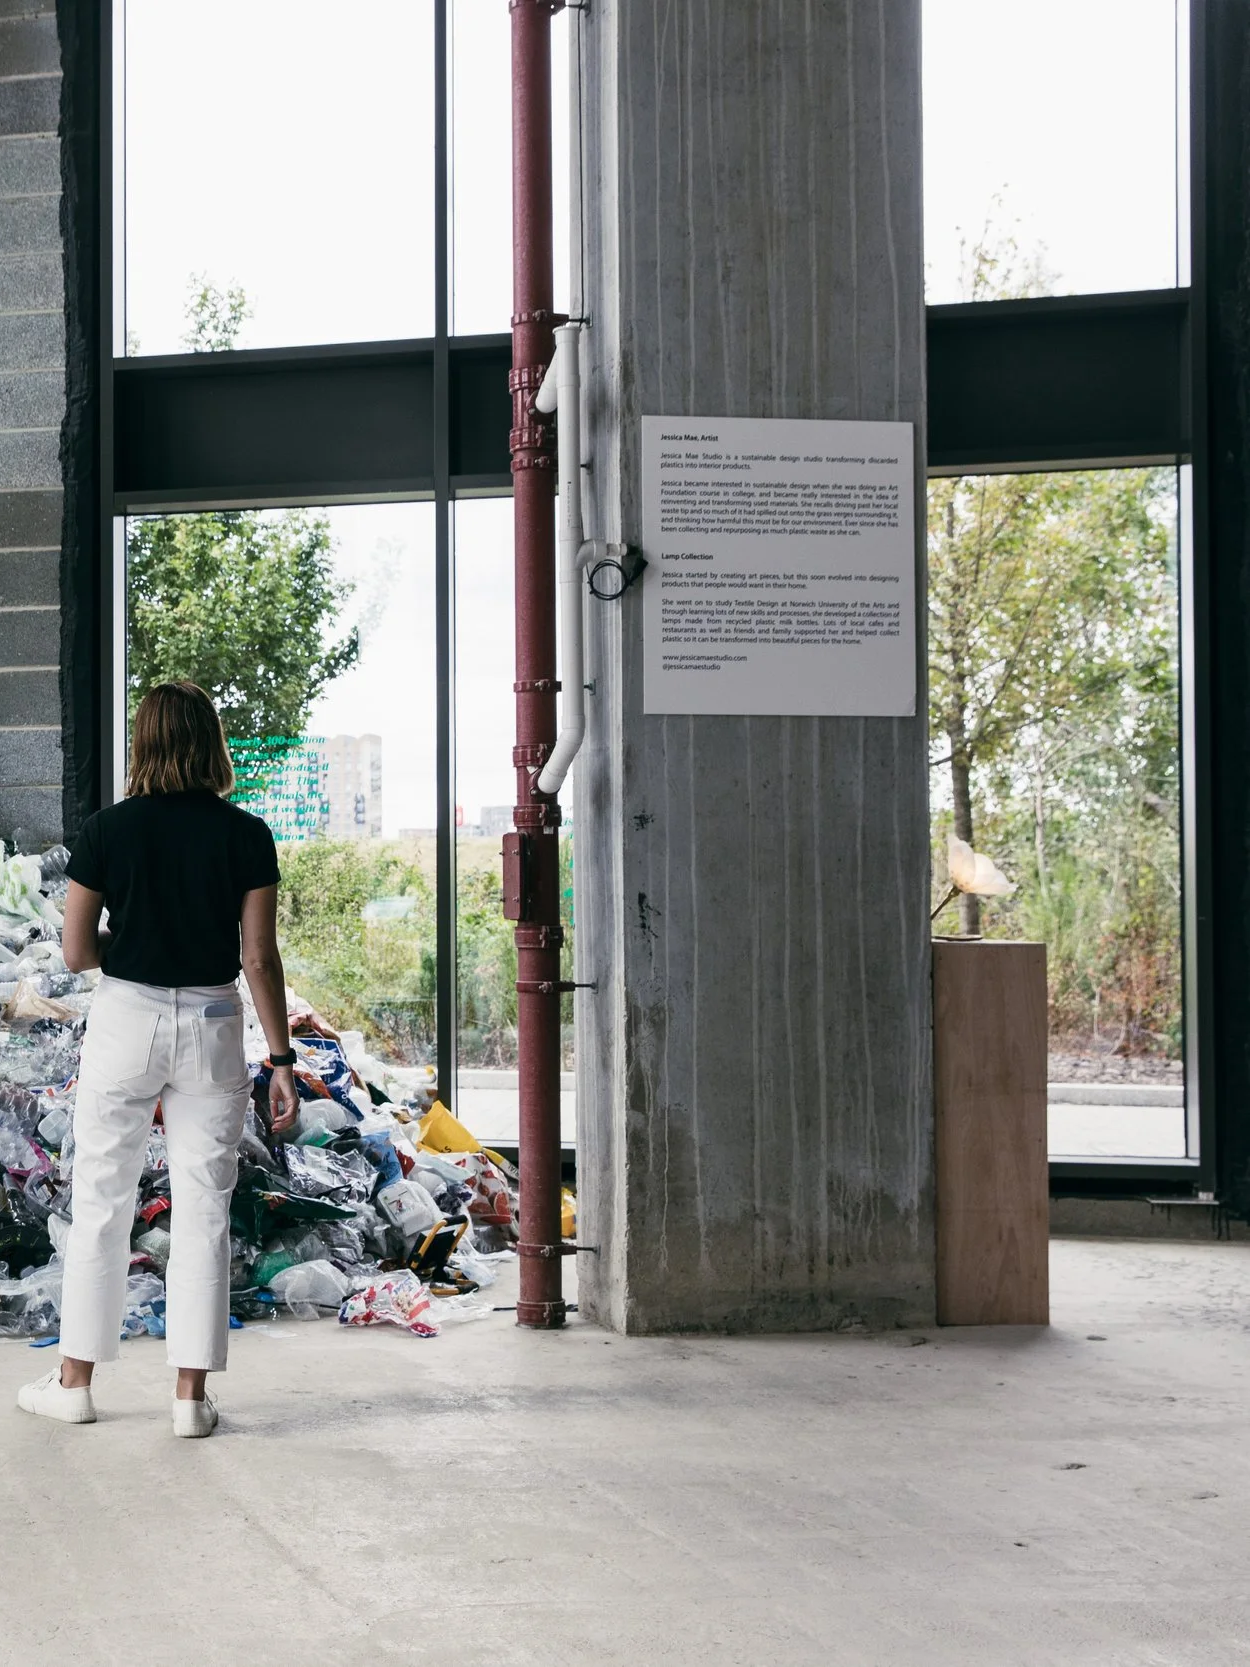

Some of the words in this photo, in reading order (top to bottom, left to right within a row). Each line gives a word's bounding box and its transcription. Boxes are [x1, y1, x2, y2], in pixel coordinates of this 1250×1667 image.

[660, 433, 682, 441] Jessica
[700, 434, 718, 442] Artist
[702, 452, 722, 460] Studio
[741, 453, 776, 461] sustainable
[779, 454, 800, 463] design
[803, 454, 822, 462] studio
[825, 455, 865, 464] transforming
[867, 456, 897, 464] discarded
[660, 461, 683, 470] plastics
[698, 462, 721, 470] interior
[683, 479, 708, 487] became
[710, 480, 742, 488] interested
[752, 481, 787, 489] sustainable
[789, 481, 810, 490] design
[857, 483, 876, 492] doing
[660, 488, 696, 496] Foundation
[800, 491, 817, 500] really
[819, 491, 851, 499] interested
[875, 492, 889, 500] idea
[678, 525, 709, 534] collecting
[723, 526, 761, 535] repurposing
[788, 527, 808, 536] plastic
[661, 552, 679, 561] Lamp
[680, 552, 713, 560] Collection
[685, 571, 707, 579] started
[720, 572, 746, 581] creating
[827, 573, 852, 581] evolved
[868, 574, 899, 583] designing
[661, 580, 689, 589] products
[690, 580, 703, 588] that
[704, 580, 726, 589] people
[772, 581, 786, 589] their
[676, 598, 692, 606] went
[714, 599, 732, 607] study
[756, 599, 778, 608] Design
[817, 600, 848, 609] University
[662, 653, 747, 662] www.jessicamaestudio.com
[662, 662, 720, 672] @jessicamaestudio
[228, 736, 261, 747] Nearly
[265, 736, 285, 745] 300
[288, 736, 326, 745] million
[278, 763, 329, 774] produced
[269, 791, 304, 801] equals
[307, 790, 323, 798] the
